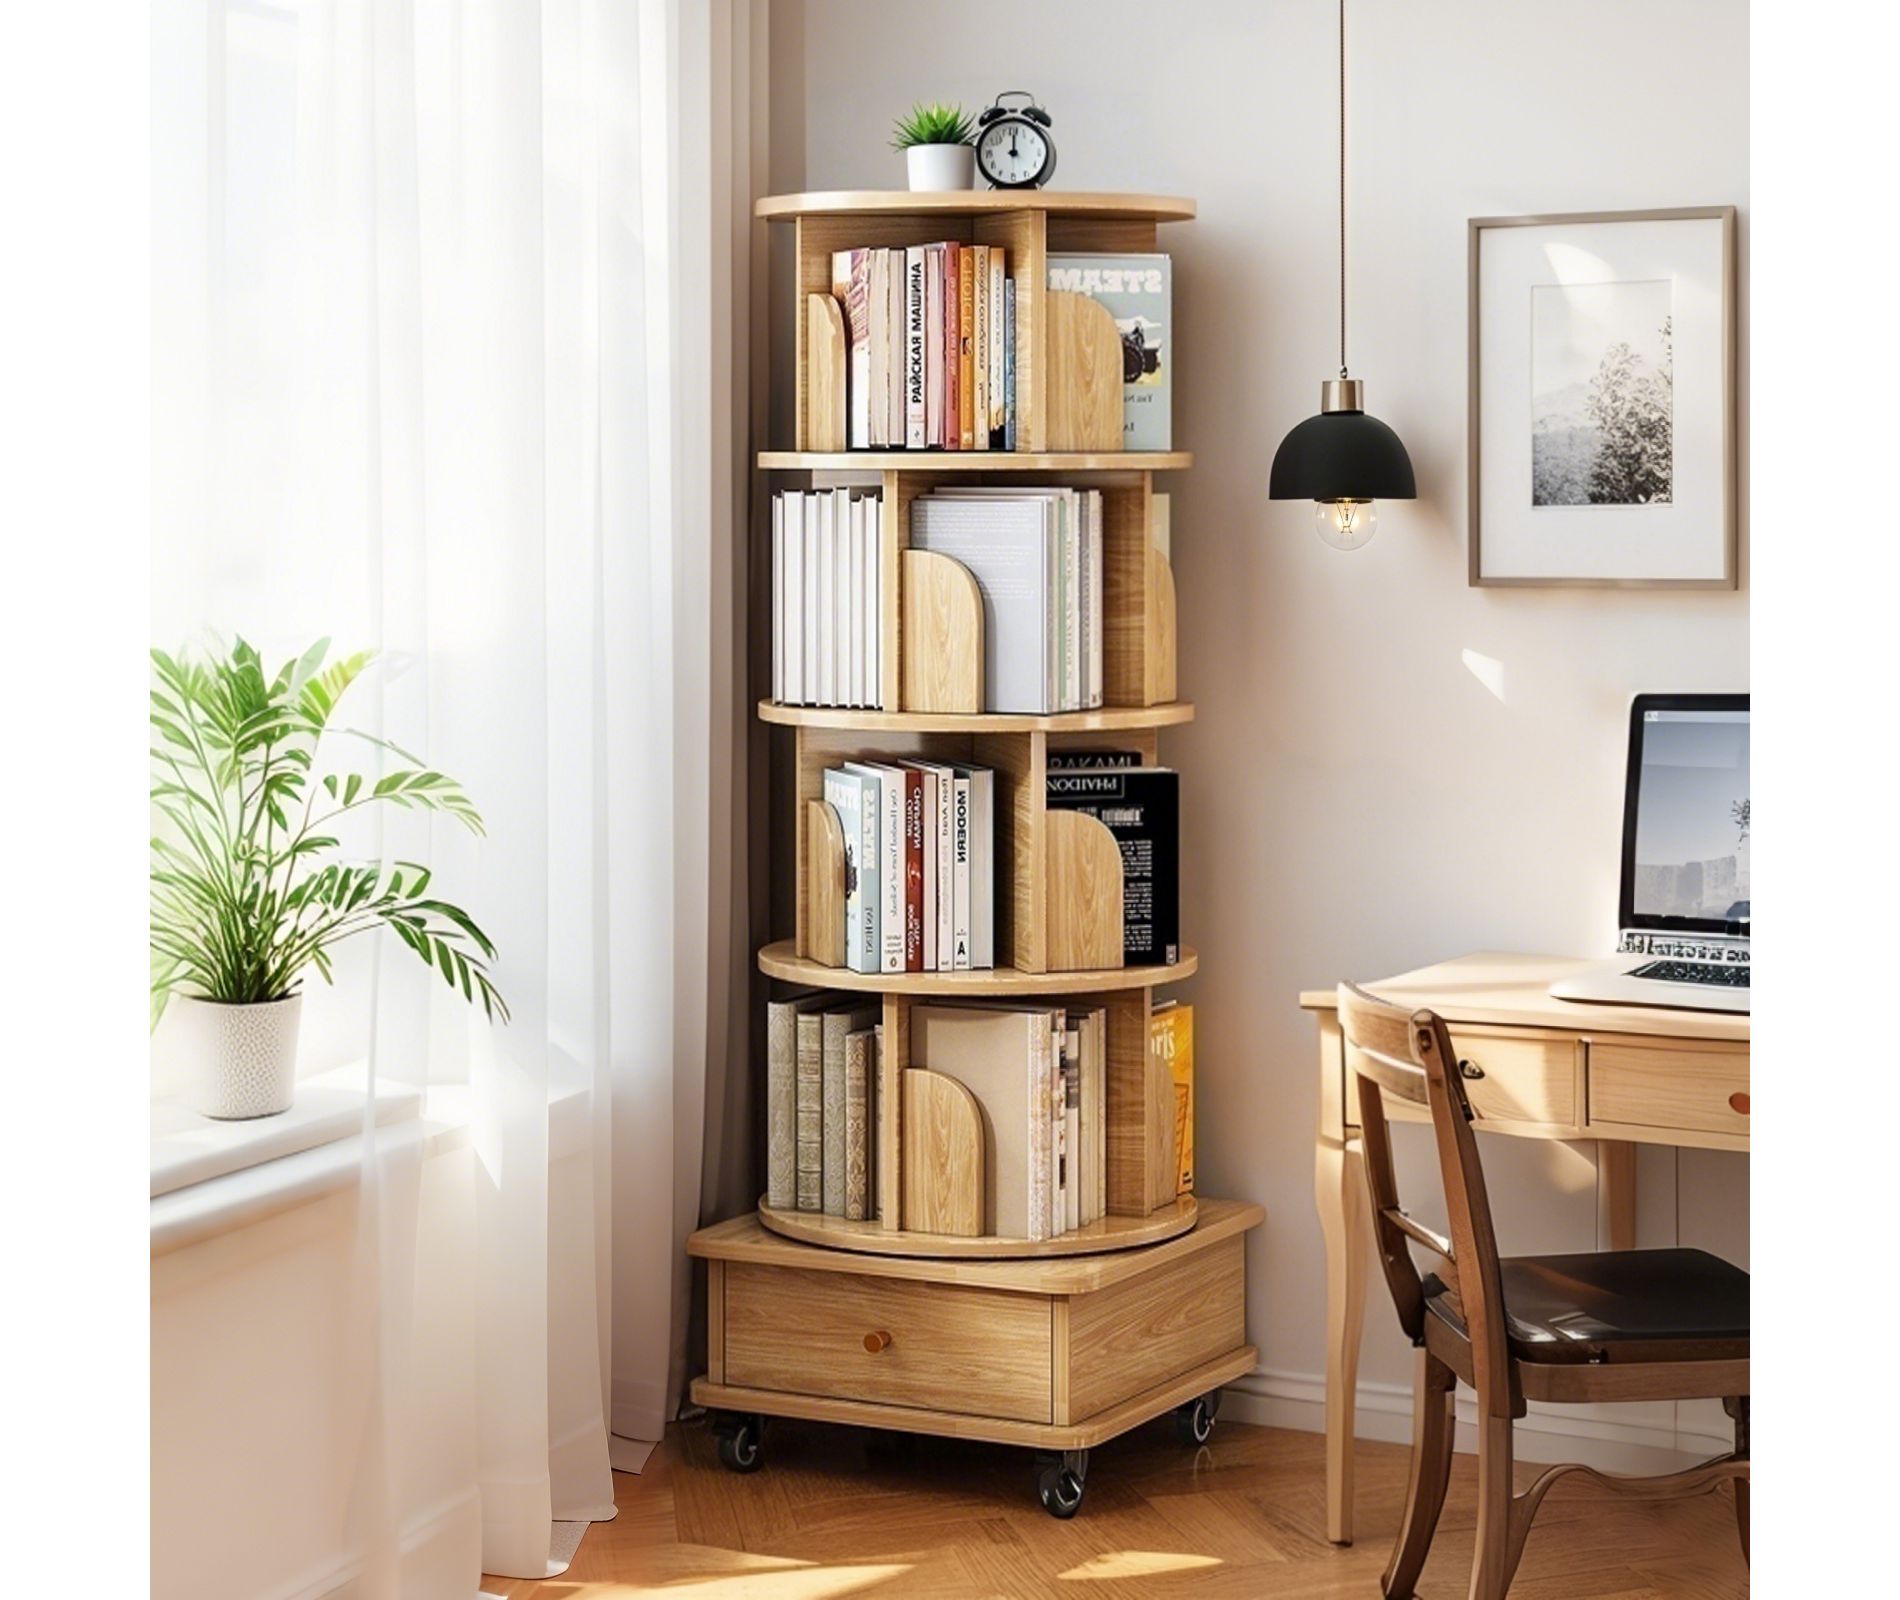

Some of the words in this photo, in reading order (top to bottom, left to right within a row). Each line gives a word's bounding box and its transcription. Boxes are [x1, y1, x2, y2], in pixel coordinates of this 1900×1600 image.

[910, 262, 922, 332] МАШИНА
[909, 337, 922, 404] РАЙСКАЯ
[1046, 777, 1117, 791] PHAIDON
